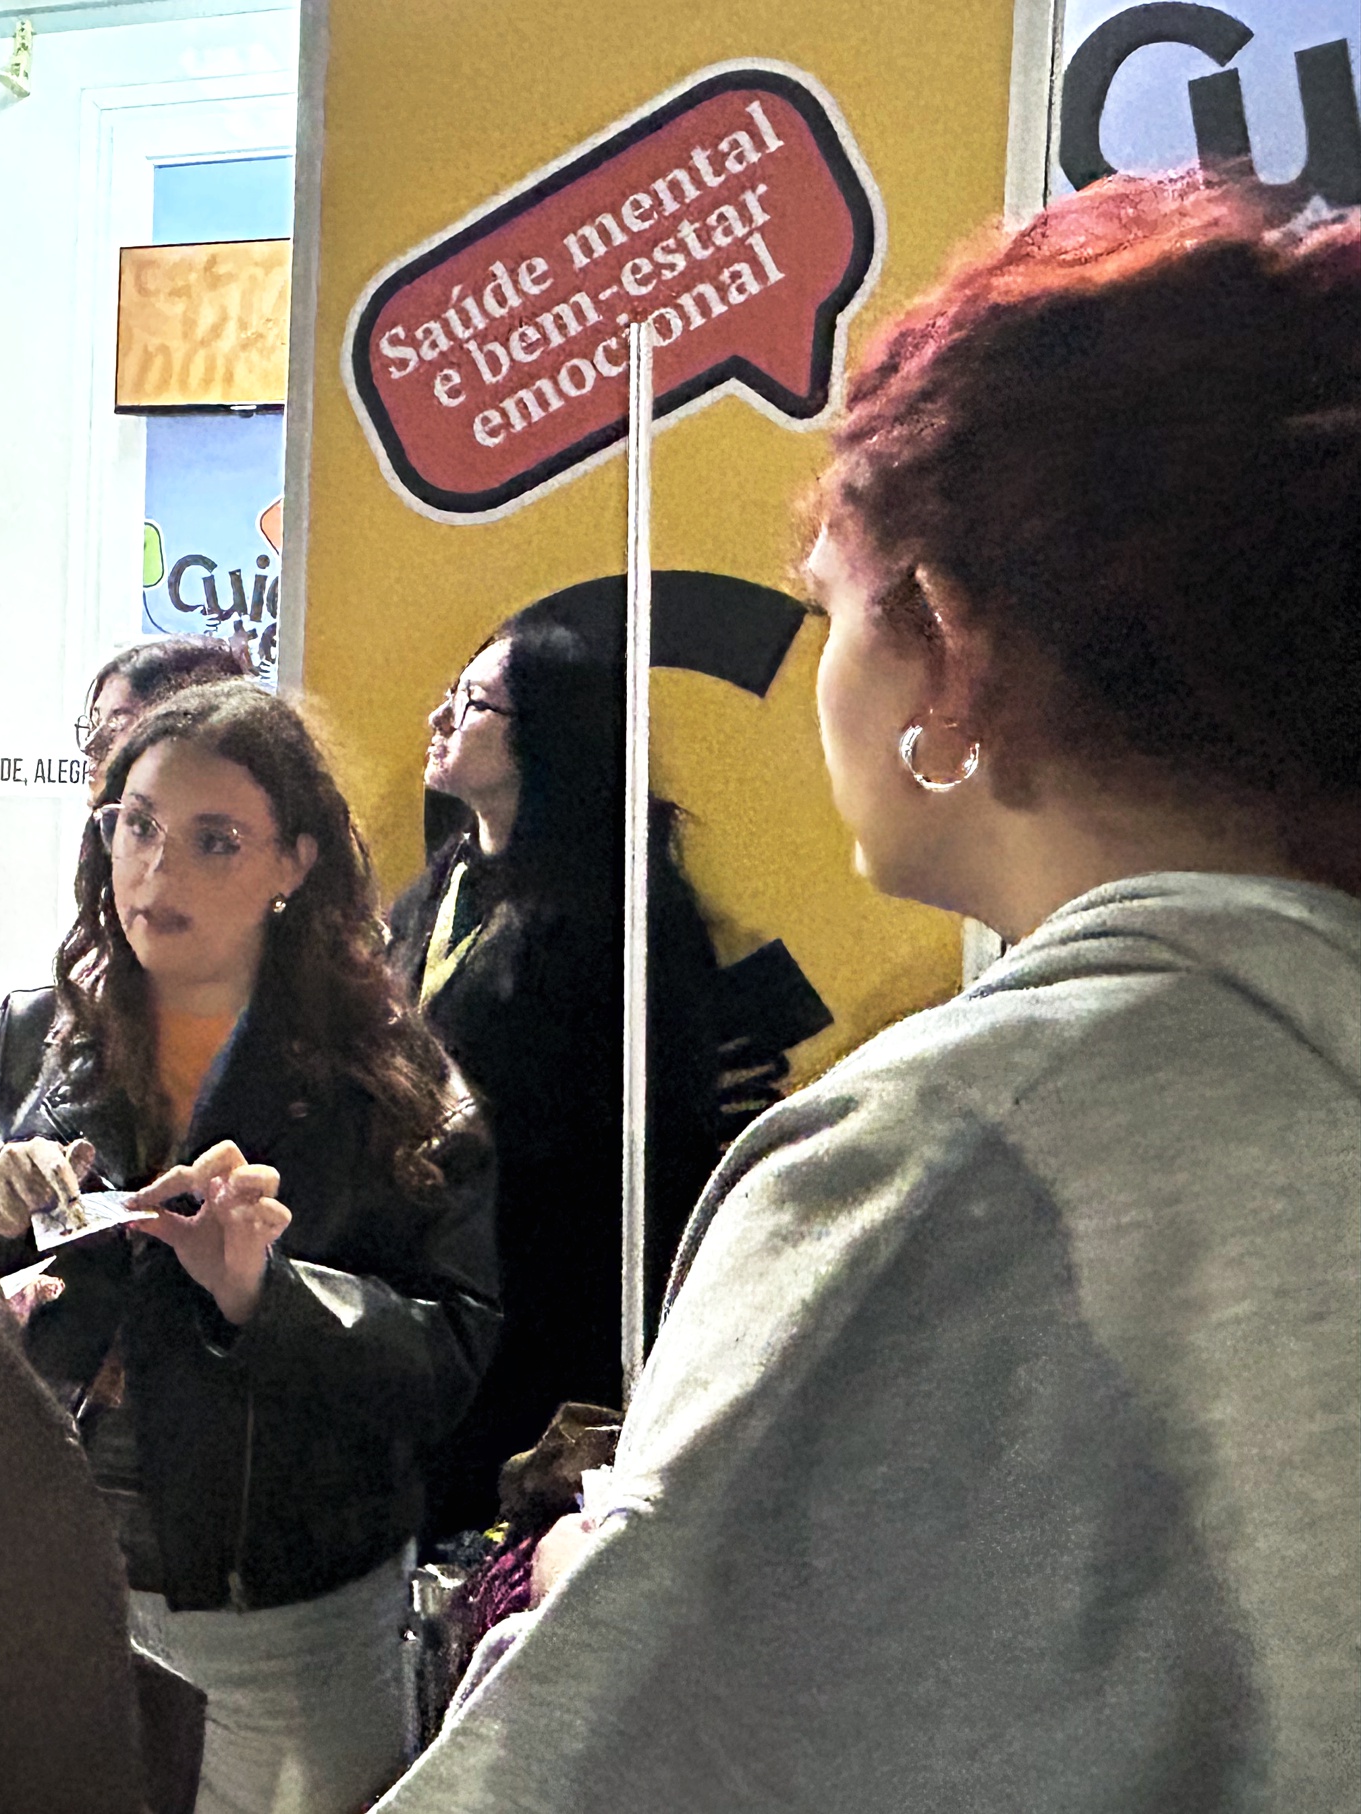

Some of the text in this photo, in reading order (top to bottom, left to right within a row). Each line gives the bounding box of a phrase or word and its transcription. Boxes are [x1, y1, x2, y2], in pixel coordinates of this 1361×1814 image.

[378, 100, 785, 379] Saúde mental
[434, 182, 772, 408] e bem-estar
[473, 232, 786, 448] emoconal
